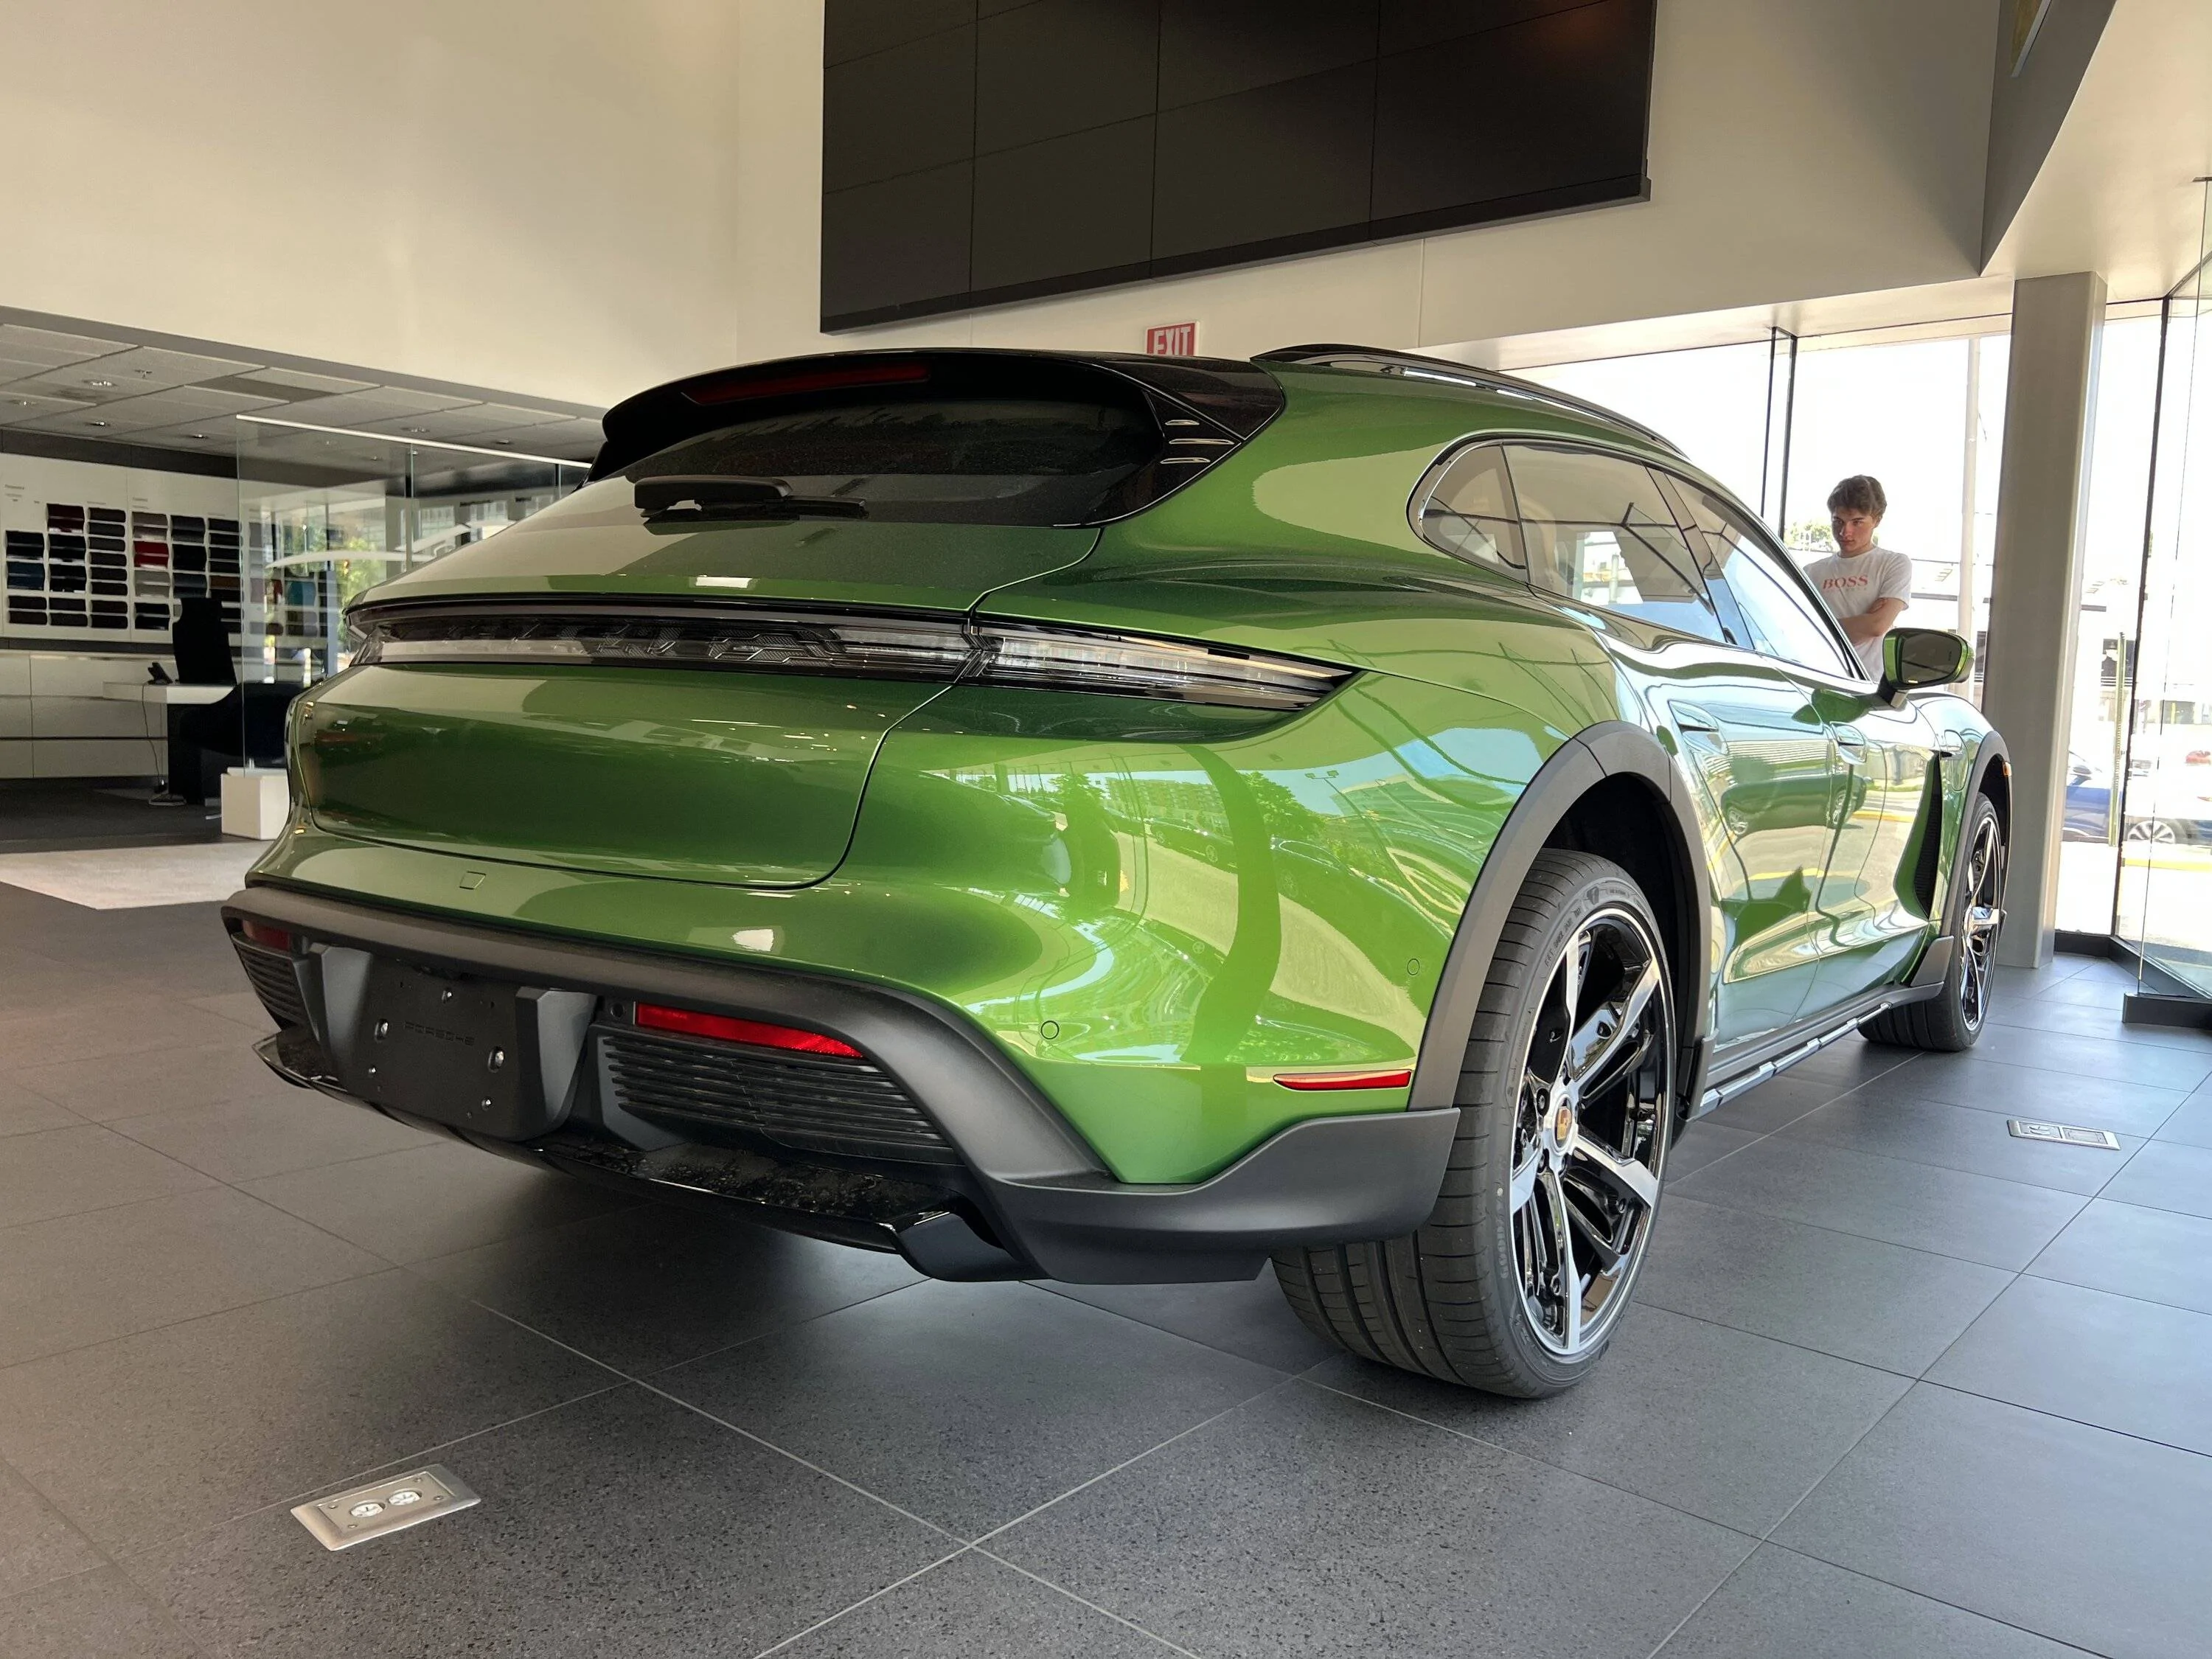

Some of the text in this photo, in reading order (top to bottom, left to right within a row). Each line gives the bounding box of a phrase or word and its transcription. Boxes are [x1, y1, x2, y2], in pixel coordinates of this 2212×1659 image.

[1153, 327, 1191, 355] EXIT
[1823, 576, 1868, 589] BOSS
[404, 1021, 475, 1046] PORSCHE
